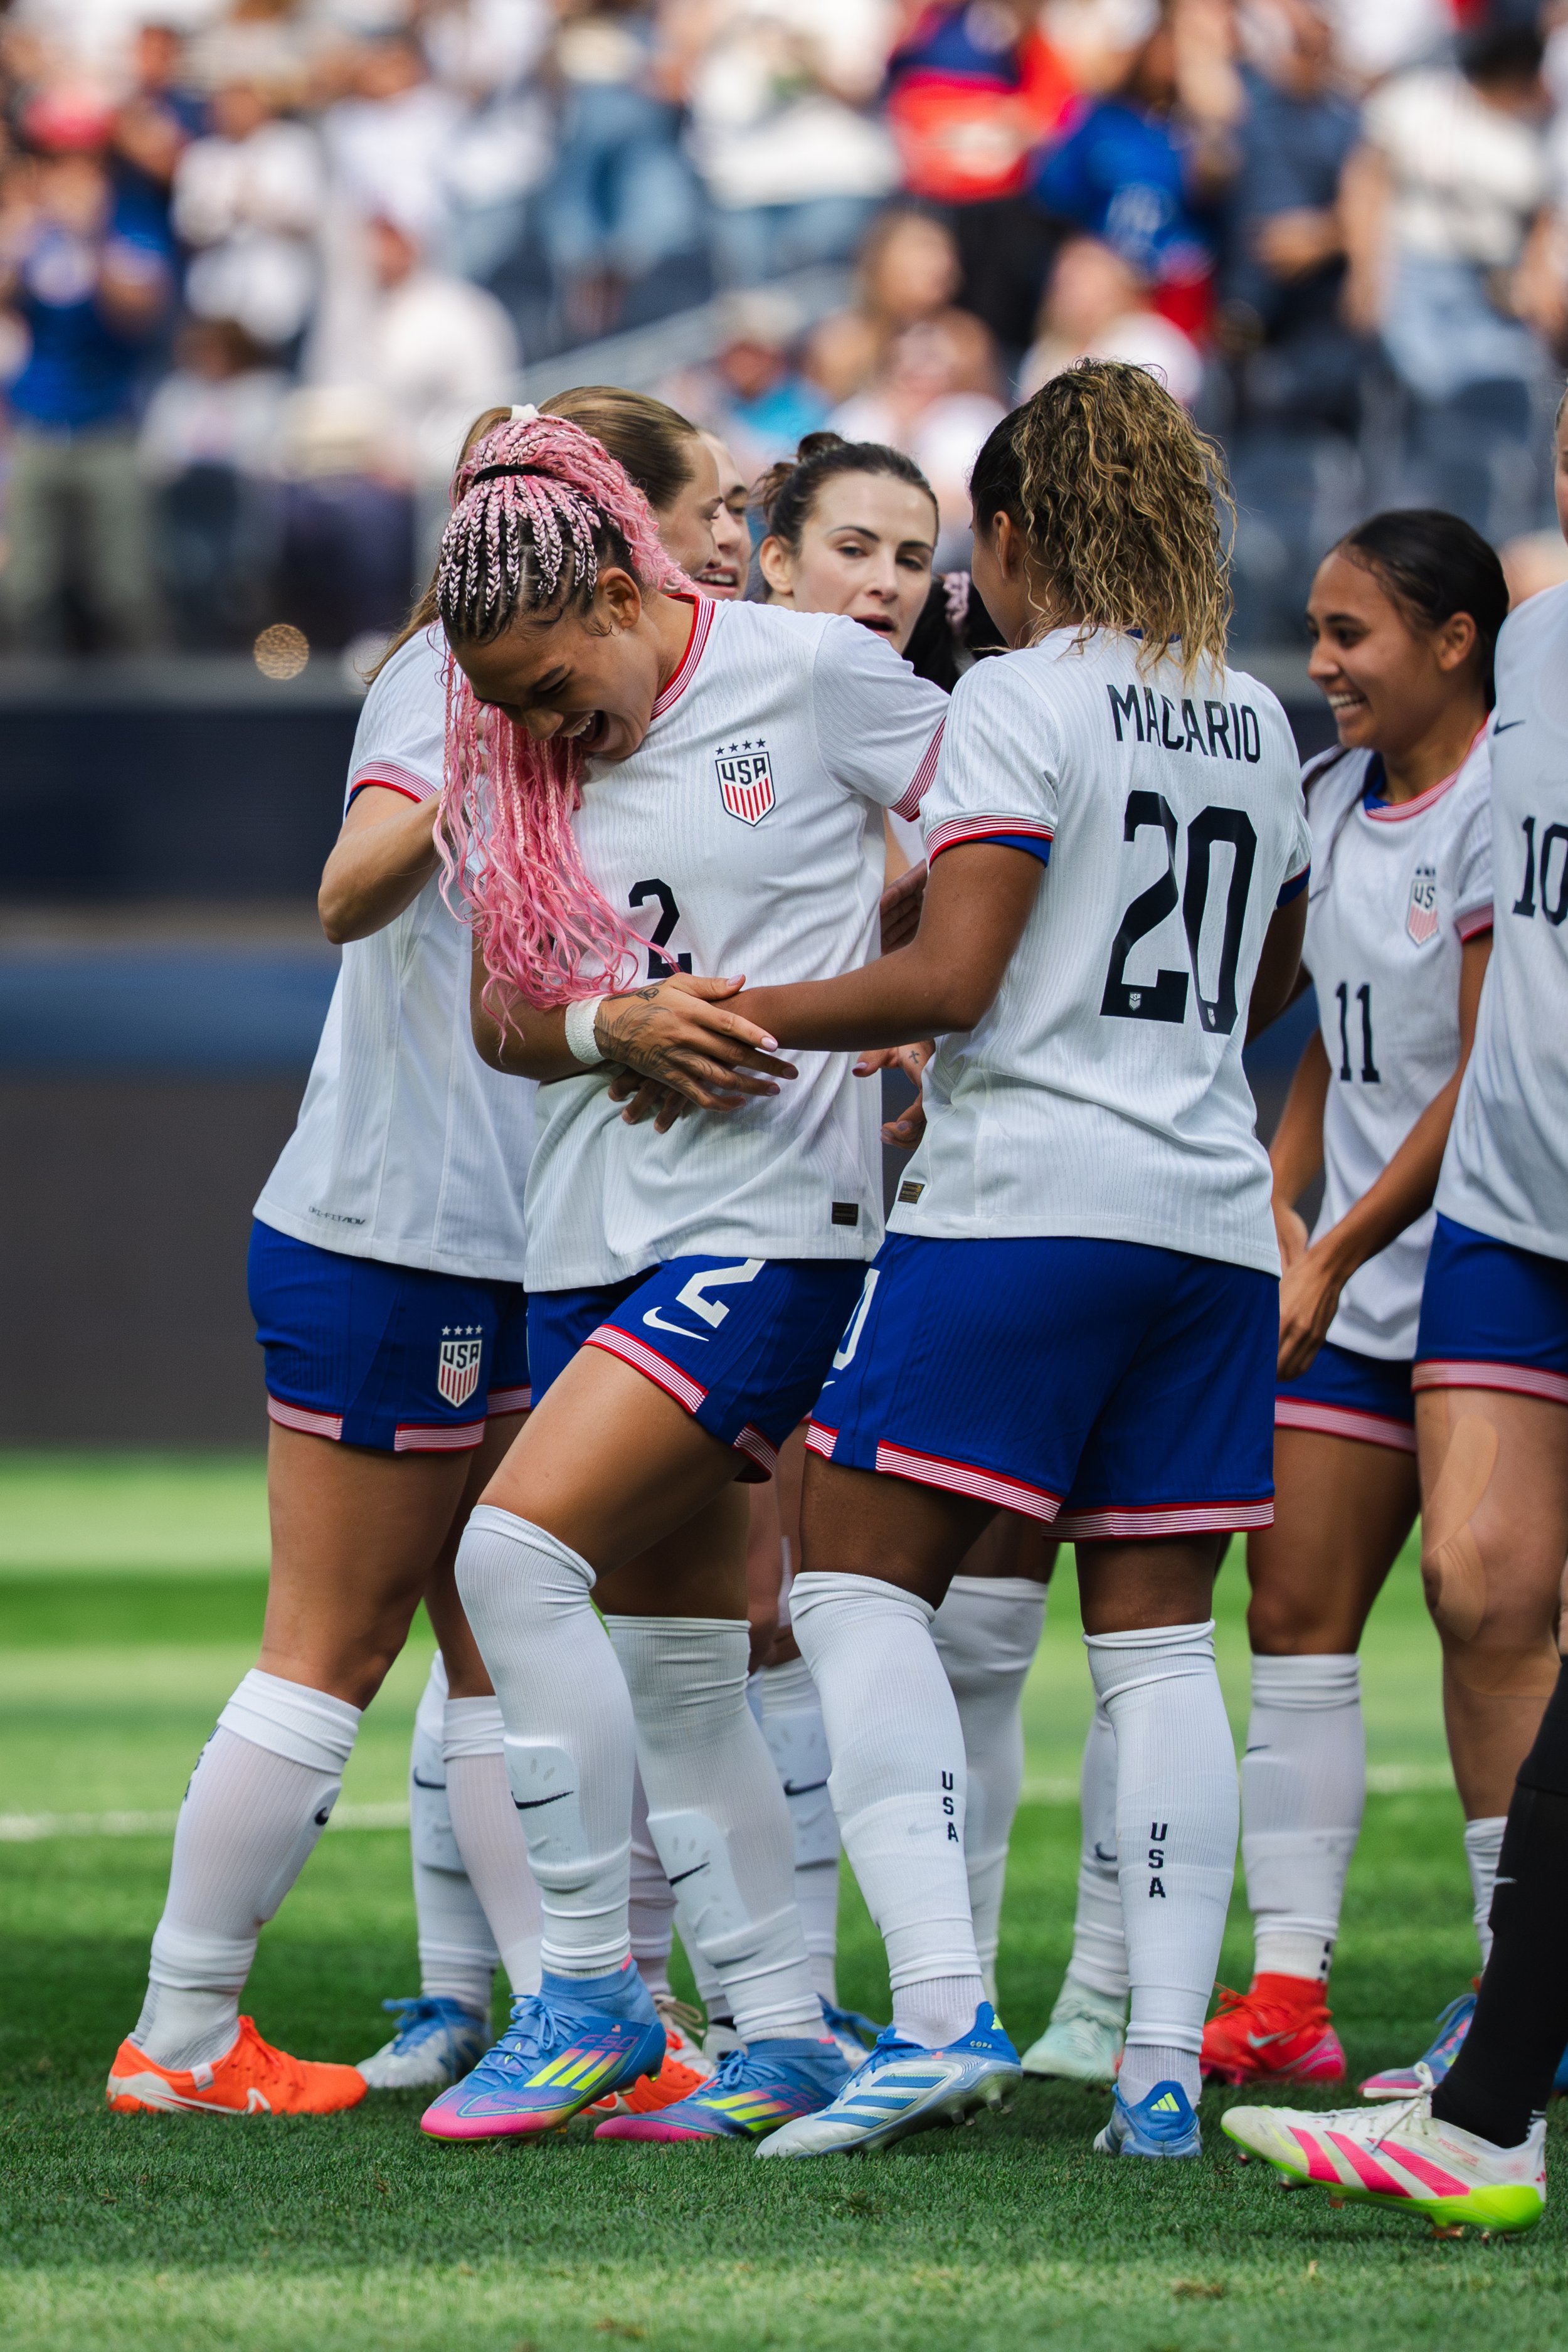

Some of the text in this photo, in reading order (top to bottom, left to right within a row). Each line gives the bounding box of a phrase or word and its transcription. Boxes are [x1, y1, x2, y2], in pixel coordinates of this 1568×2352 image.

[1106, 684, 1261, 764] MACARIO
[721, 757, 766, 785] USA
[1414, 884, 1435, 908] US
[1513, 816, 1568, 926] 10
[628, 878, 692, 979] 2
[1099, 790, 1258, 1036] 20
[1336, 982, 1380, 1082] 11
[675, 1258, 766, 1328] 2
[443, 1343, 479, 1369] USA
[941, 1770, 959, 1843] USA
[1148, 1822, 1168, 1898] USA
[574, 2034, 639, 2050] F50
[970, 2040, 992, 2049] COPA
